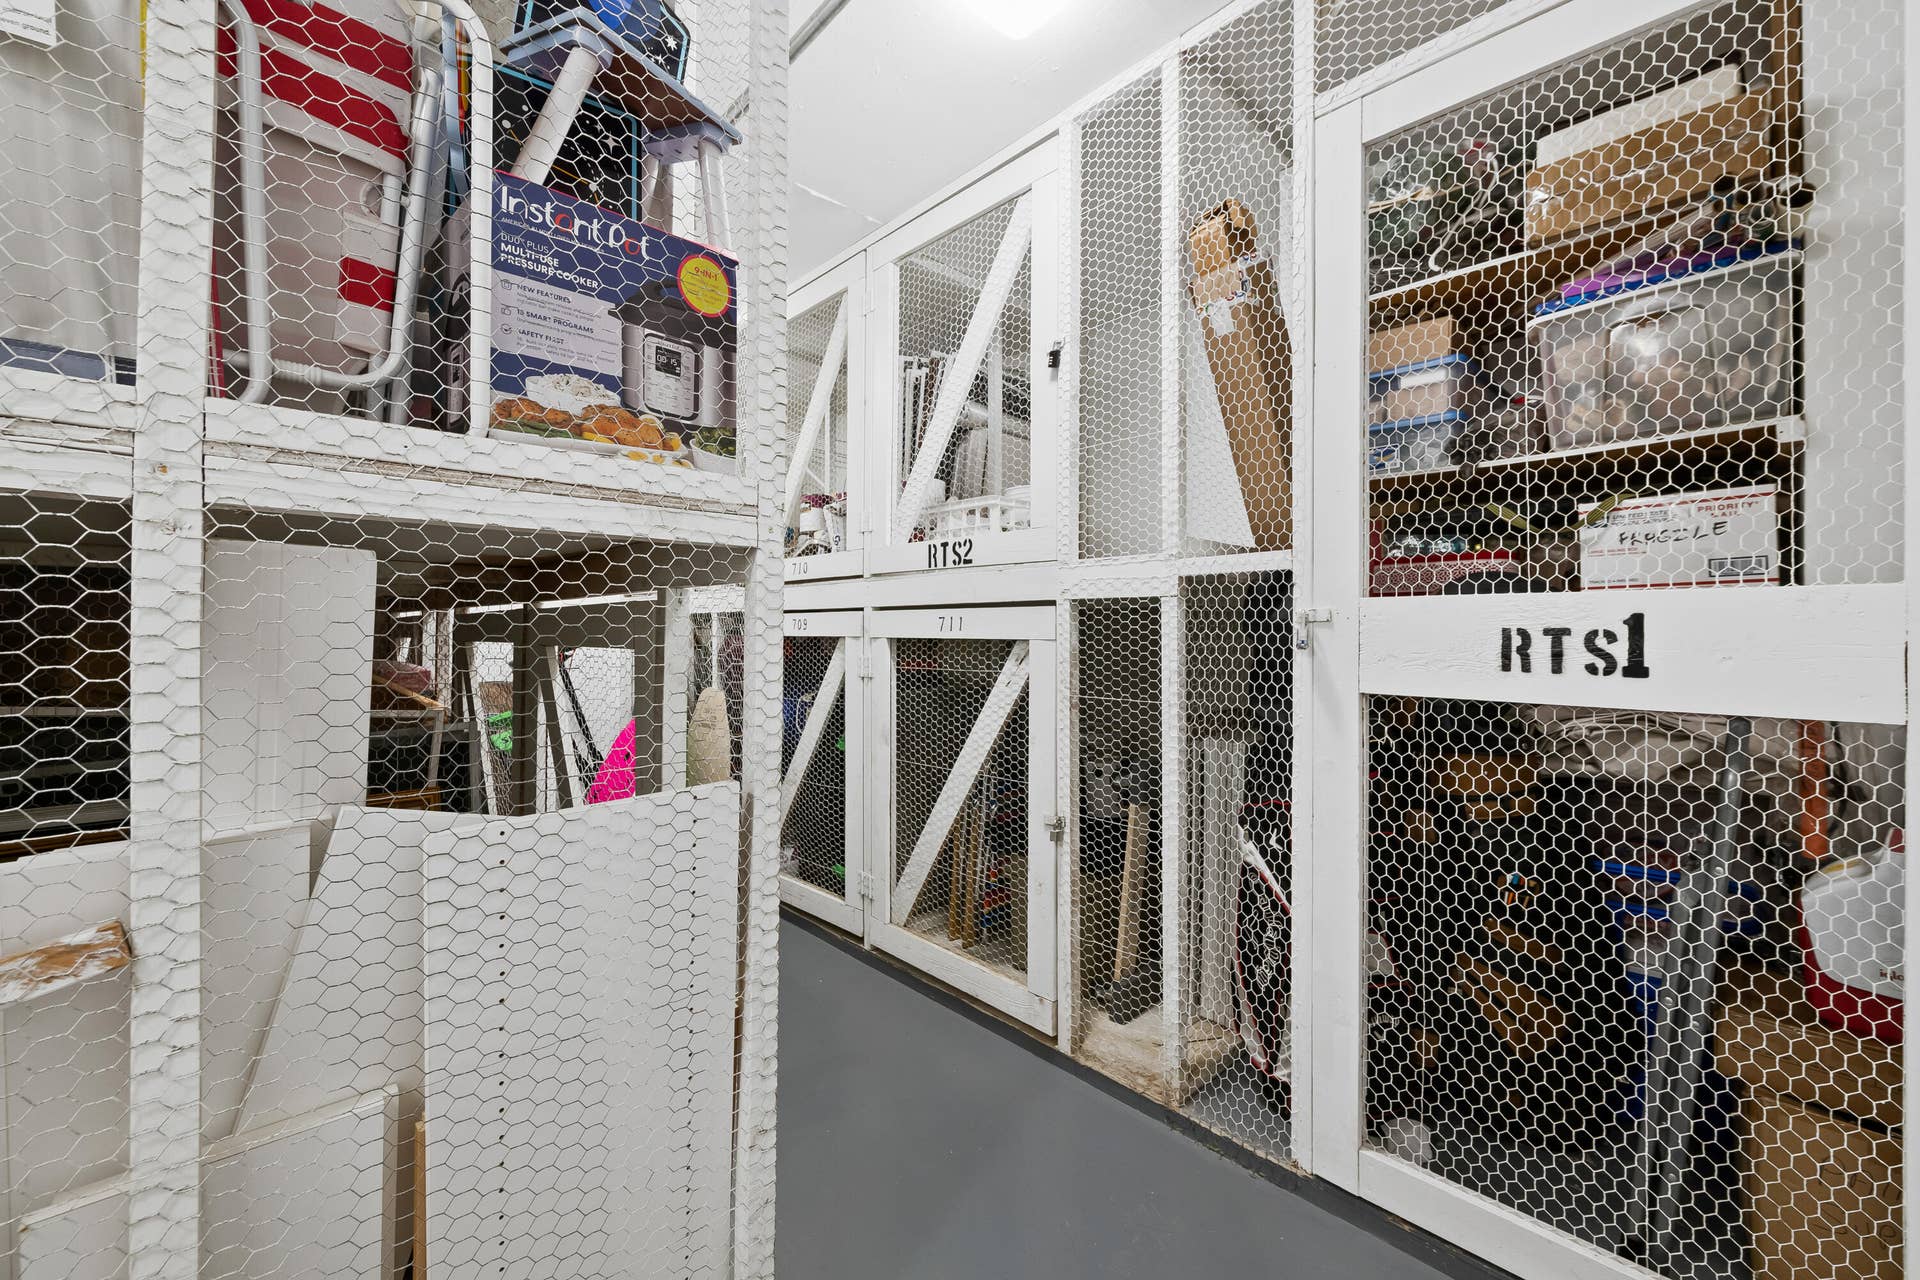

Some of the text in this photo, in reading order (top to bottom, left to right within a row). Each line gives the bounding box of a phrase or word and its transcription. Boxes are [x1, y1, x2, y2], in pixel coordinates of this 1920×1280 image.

[501, 185, 650, 260] Instant Pot
[500, 242, 559, 267] MULTI-USE
[526, 241, 549, 253] PLUS
[500, 253, 599, 289] PRESSURE COOKER
[517, 284, 536, 295] NEW
[553, 318, 594, 334] PROGRAMS
[928, 538, 973, 569] RTS2
[791, 562, 808, 575] 710
[792, 618, 808, 631] 709
[938, 616, 964, 632] 711
[1500, 612, 1650, 678] RTS1
